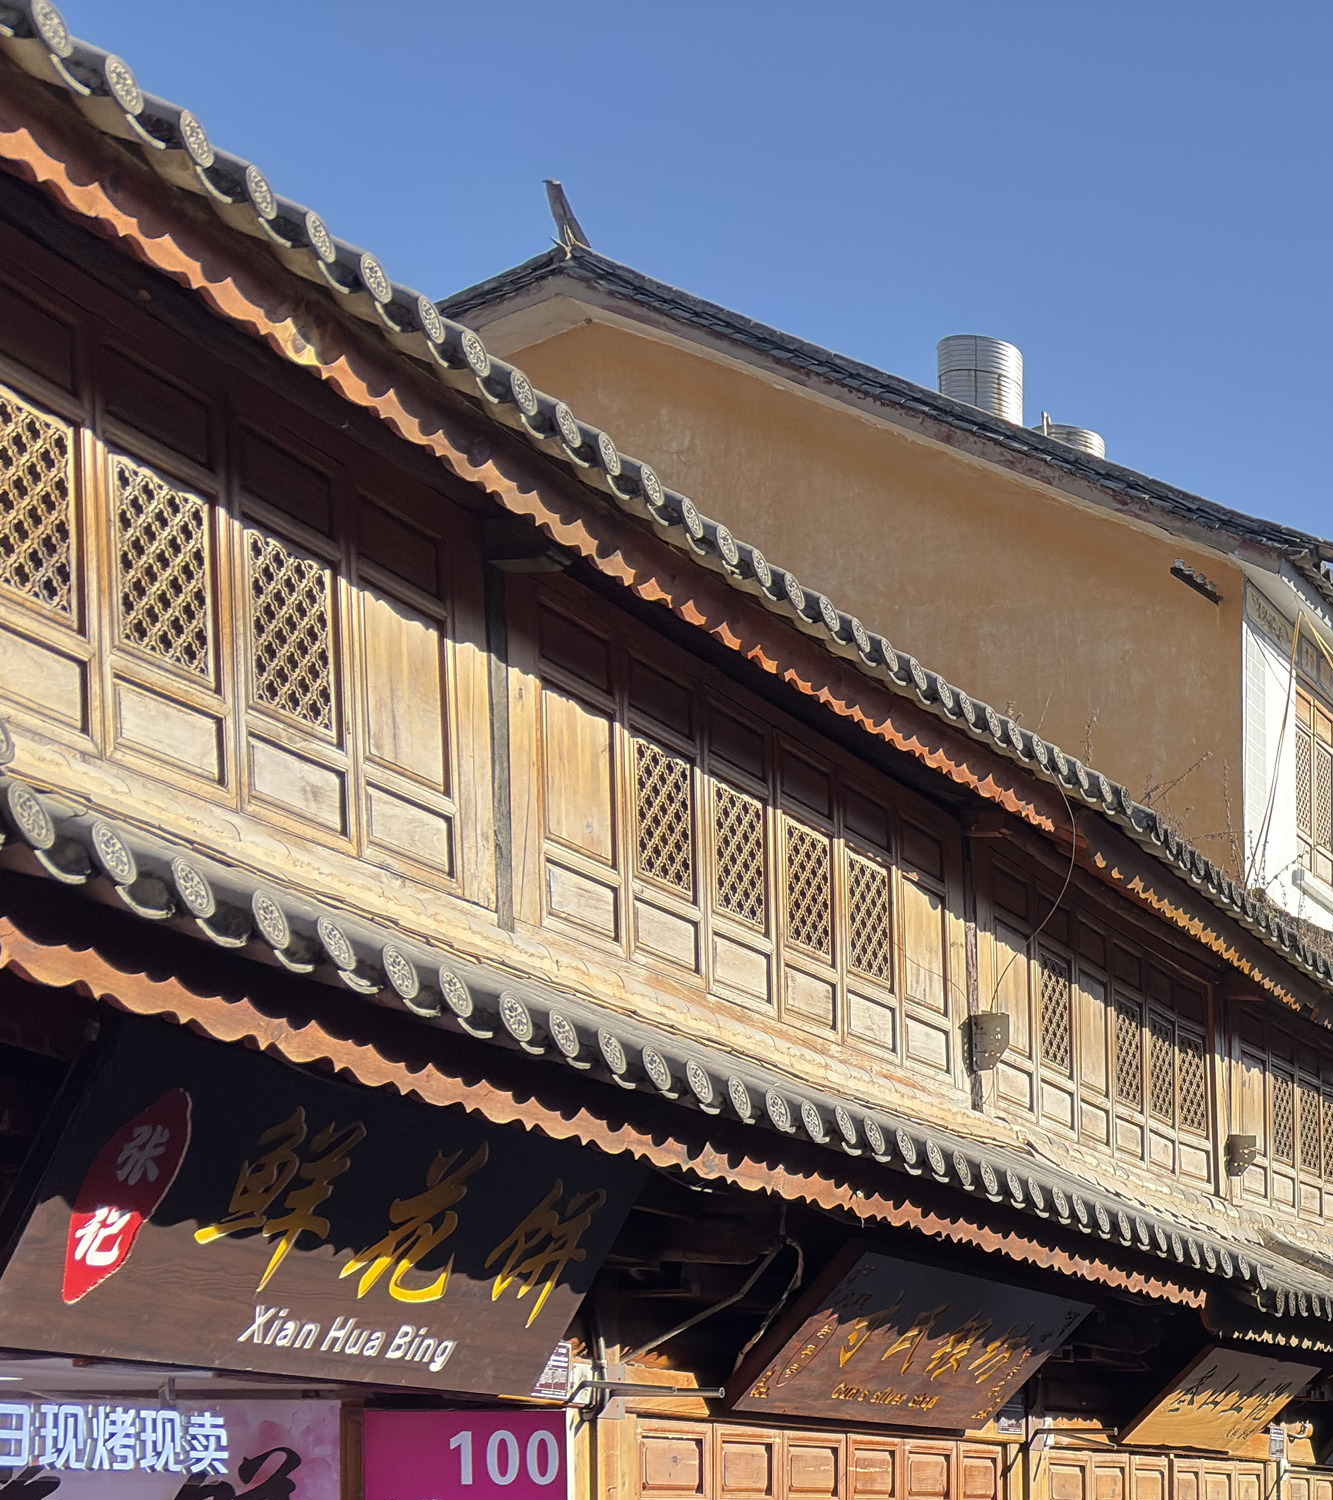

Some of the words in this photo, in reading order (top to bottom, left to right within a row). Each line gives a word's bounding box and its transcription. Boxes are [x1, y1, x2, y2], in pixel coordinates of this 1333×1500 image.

[75, 1124, 170, 1268] 张记
[195, 1105, 606, 1328] 鲜花饼
[237, 1305, 319, 1350] Xian
[321, 1317, 384, 1358] Hua
[389, 1325, 457, 1372] Bing
[870, 1386, 910, 1406] silver
[908, 1394, 941, 1412] shop
[449, 1429, 560, 1487] 100
